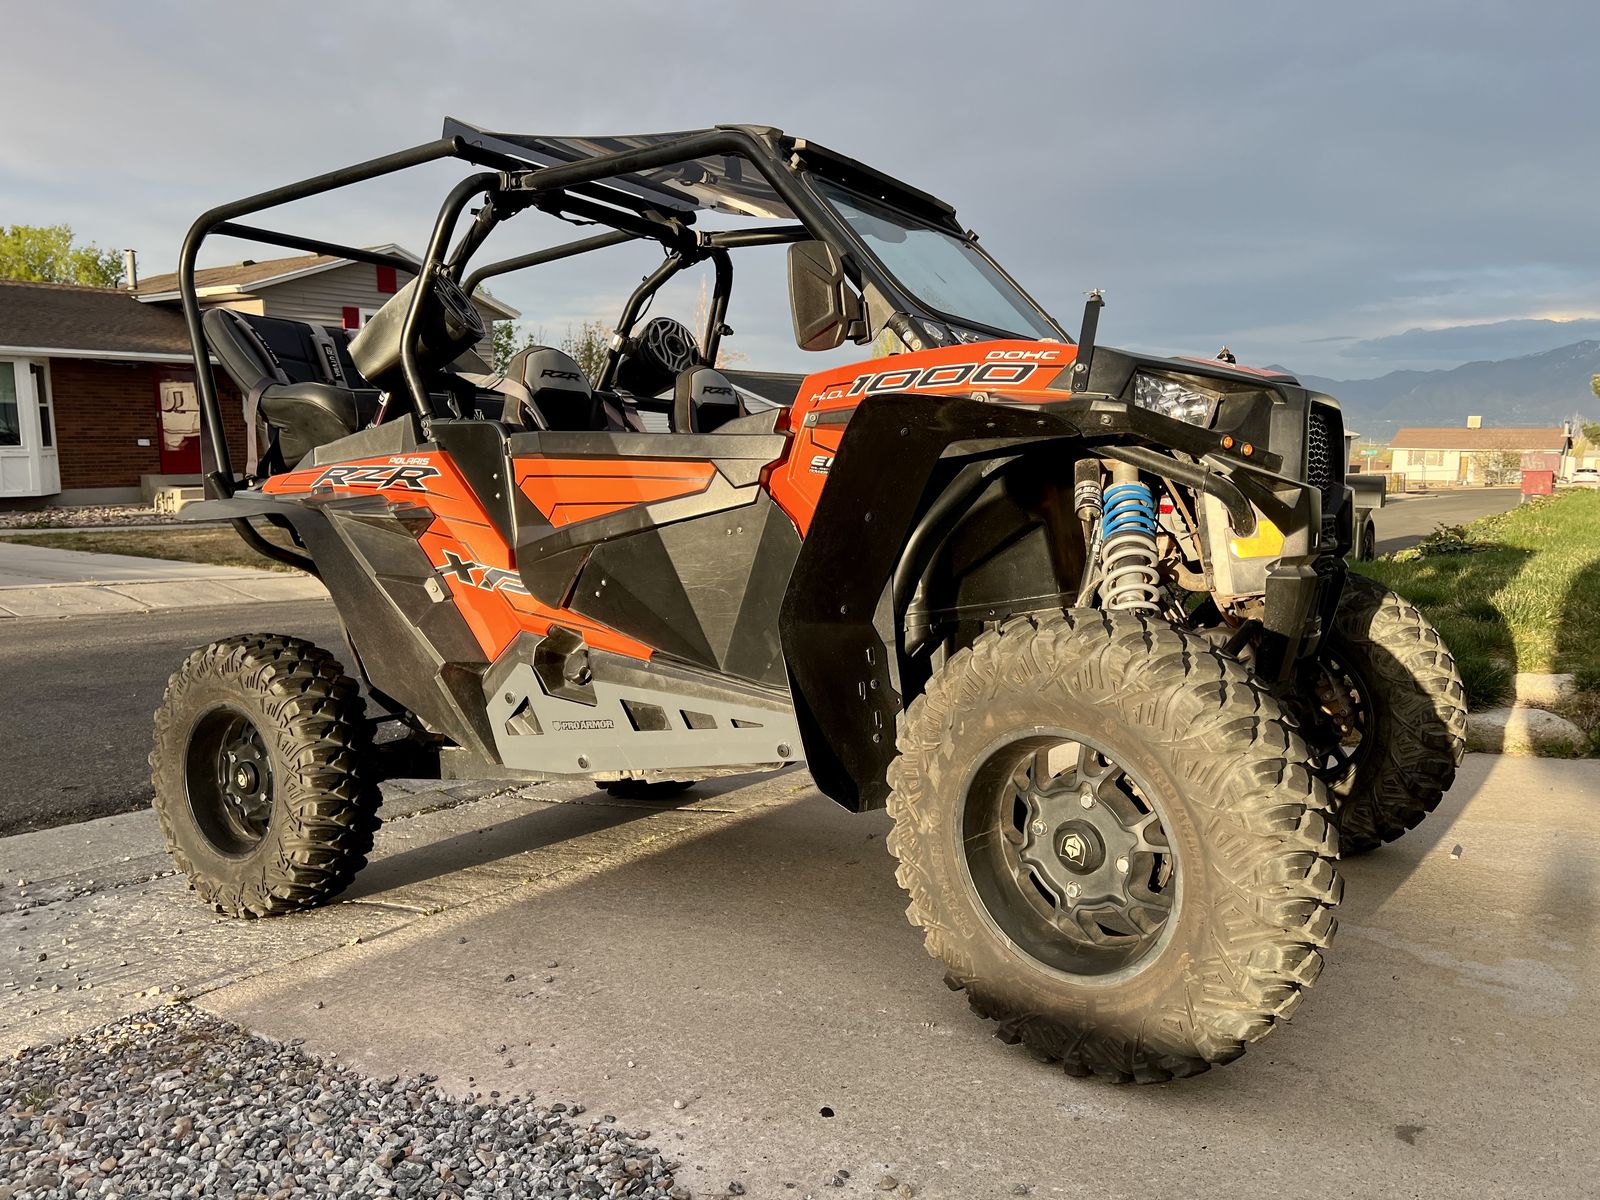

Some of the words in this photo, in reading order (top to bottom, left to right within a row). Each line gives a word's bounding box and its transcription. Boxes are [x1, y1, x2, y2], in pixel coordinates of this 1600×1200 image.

[985, 350, 1060, 360] DOHC
[540, 369, 581, 382] RZR
[845, 361, 1039, 398] 1000
[702, 386, 732, 396] RZR
[388, 457, 430, 466] POLARIS
[310, 465, 442, 491] RZR
